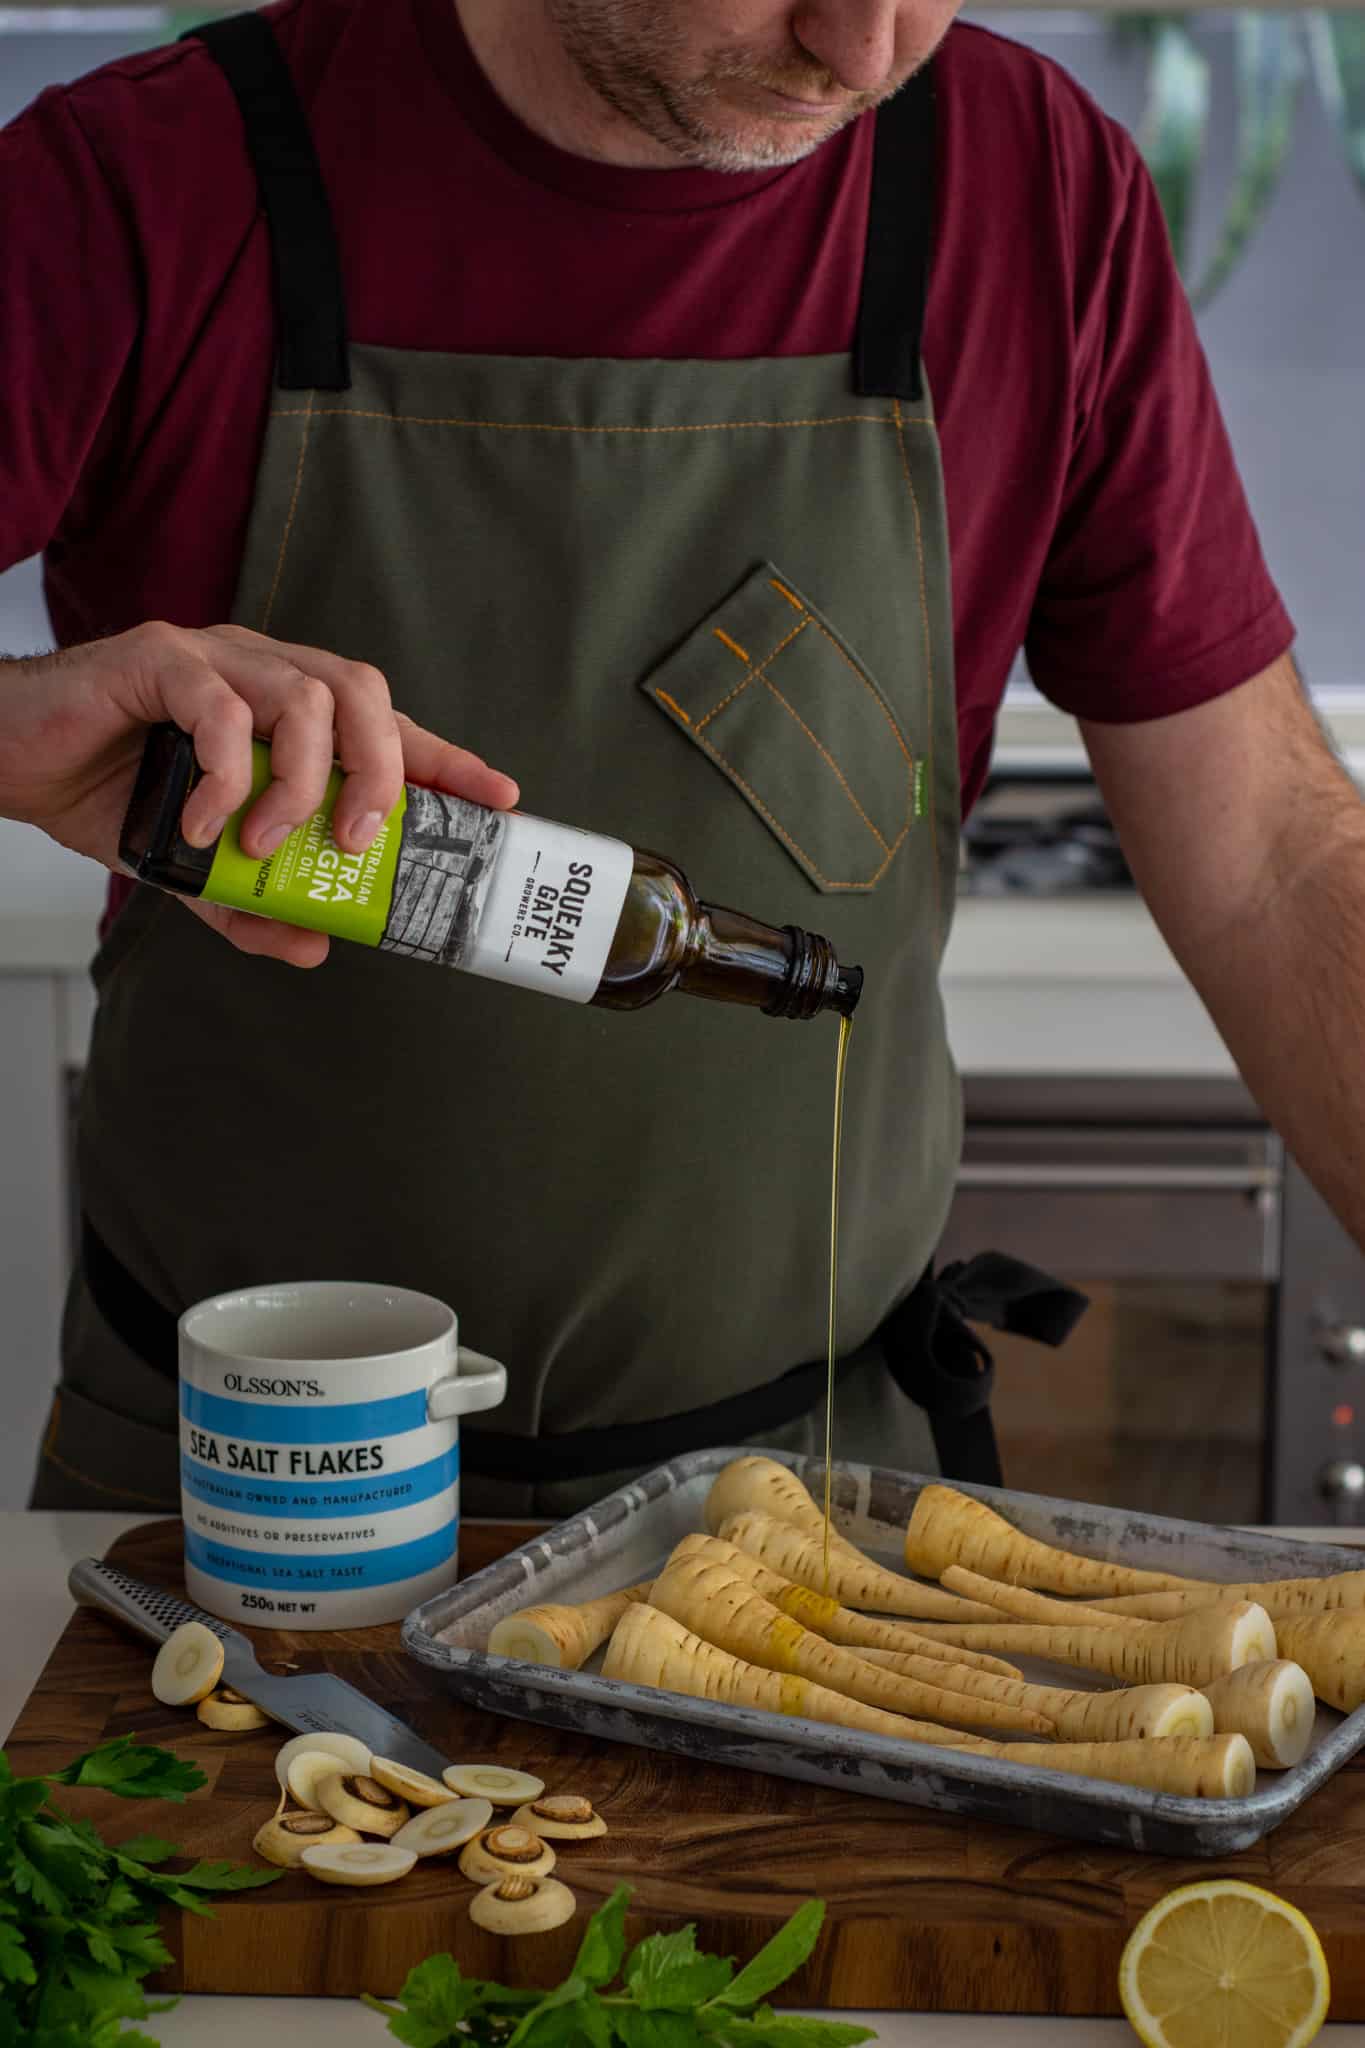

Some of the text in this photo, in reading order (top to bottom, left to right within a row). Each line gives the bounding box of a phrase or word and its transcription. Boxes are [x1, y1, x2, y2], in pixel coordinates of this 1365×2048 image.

[296, 814, 326, 878] OLIVE OIL
[331, 851, 366, 902] TRA
[516, 877, 535, 921] GROWERS
[524, 885, 559, 941] GATE
[541, 862, 592, 976] SQUEAKY
[224, 1373, 320, 1397] OLSSON'S
[190, 1430, 384, 1475] SEA SALT FLAKES
[246, 1491, 288, 1505] OWNED
[291, 1495, 318, 1505] AND
[323, 1483, 413, 1506] MANUFACTURED
[210, 1519, 259, 1539] ADDITIVES
[264, 1531, 280, 1541] OR
[285, 1528, 376, 1543] PRESERVATIVES
[272, 1566, 293, 1577] SEA
[298, 1568, 324, 1579] SALT
[330, 1566, 364, 1577] TASTE
[278, 1601, 297, 1613] NET
[301, 1602, 316, 1614] WT
